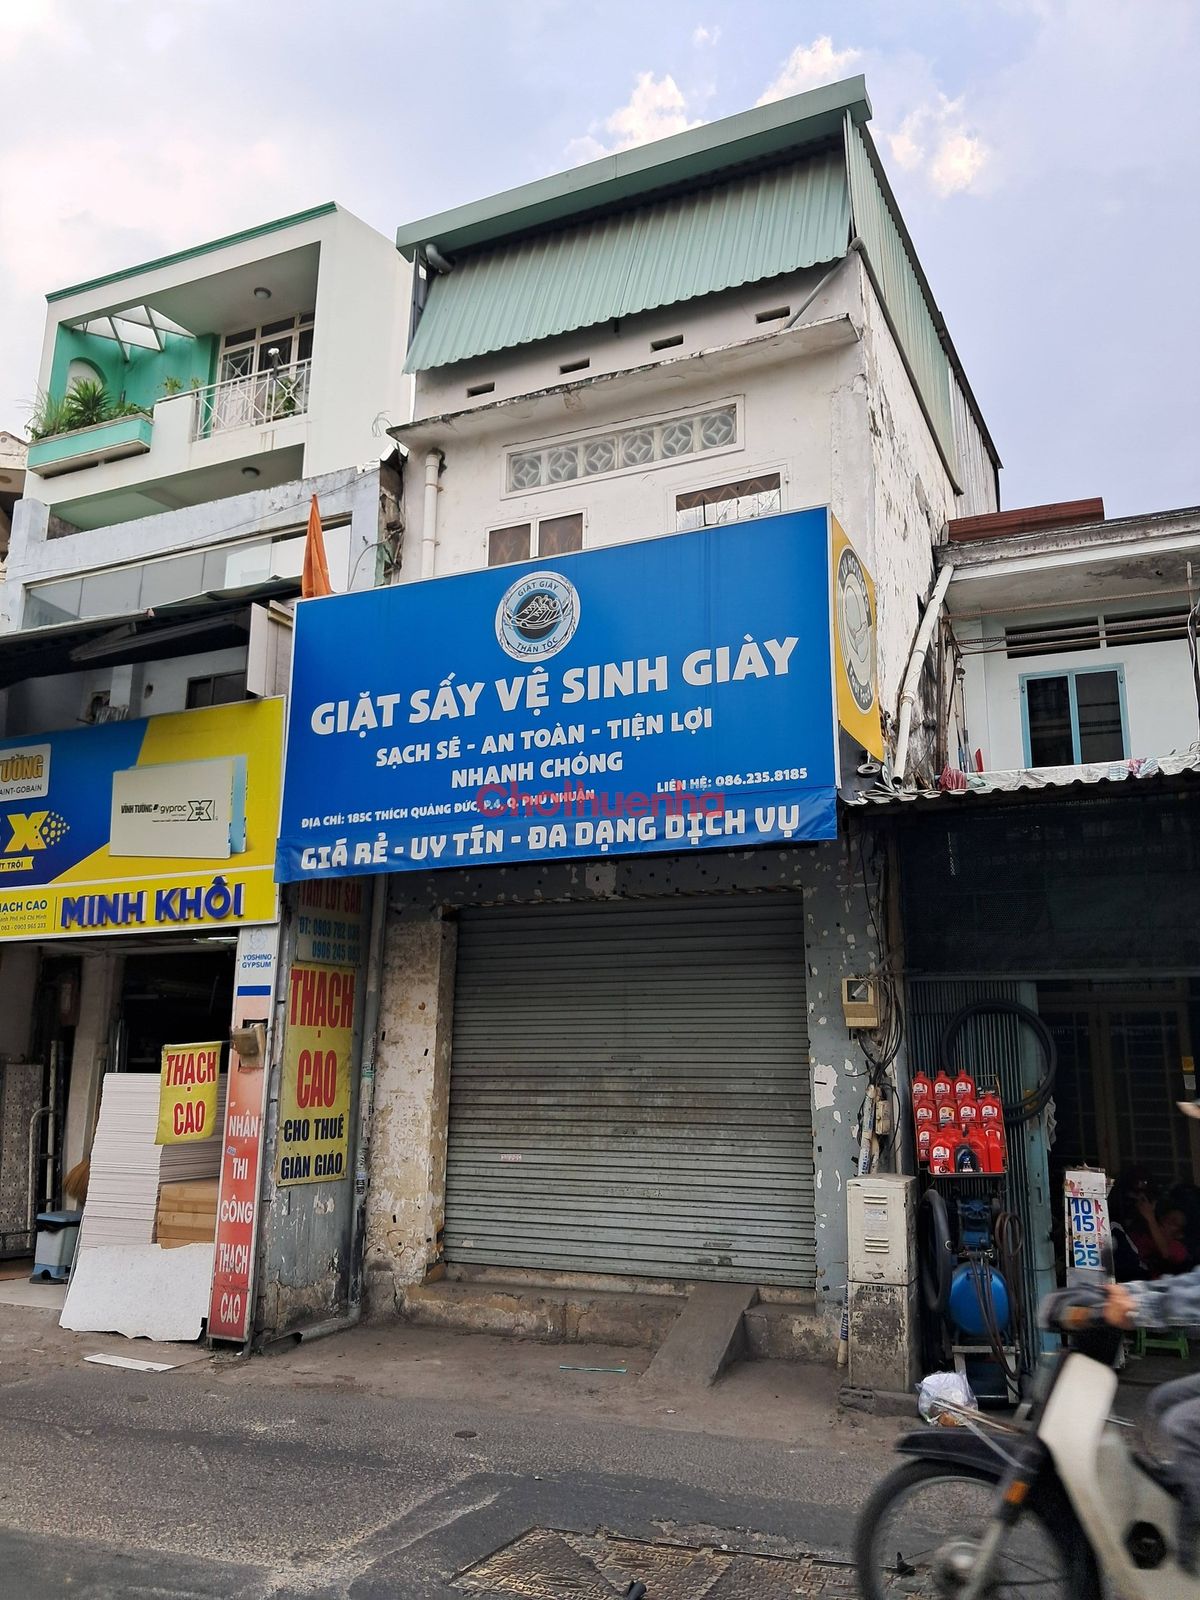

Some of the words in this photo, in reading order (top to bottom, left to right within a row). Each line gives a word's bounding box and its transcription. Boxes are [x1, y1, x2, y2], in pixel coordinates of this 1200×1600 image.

[310, 690, 400, 738] GIẶT
[408, 672, 486, 724] SẤY
[494, 665, 550, 716] VỆ
[561, 655, 668, 704] SINH
[681, 633, 799, 686] GIÀY
[376, 743, 430, 769] SẠCH
[436, 736, 461, 760] SẼ
[481, 733, 514, 755] AN
[520, 722, 585, 749] TOÀN
[606, 712, 664, 741] TIỆN
[671, 706, 713, 735] LỢI
[451, 761, 534, 789] NHANH
[540, 751, 623, 778] CHÓNG
[657, 778, 687, 793] LIÊN
[690, 775, 712, 791] HỆ:
[715, 768, 808, 787] 086.235.8185
[160, 804, 187, 814] gyproc
[301, 816, 321, 830] ĐỊA
[347, 811, 373, 824] 185C
[375, 807, 409, 821] THÍCH
[550, 788, 595, 804] NHUẬN
[300, 838, 348, 870] GIÁ
[354, 832, 389, 866] RẺ
[410, 833, 447, 861] UY
[453, 824, 504, 856] TÍN
[528, 824, 567, 850] ĐA
[575, 816, 657, 852] DẠNG
[665, 808, 746, 845] DỊCH
[754, 804, 800, 838] VỤ
[25, 899, 48, 911] CAO
[61, 890, 148, 928] MINH
[155, 875, 246, 923] KHÔI
[243, 953, 272, 961] YOSHINO
[290, 968, 355, 1039] THẠCH
[166, 1051, 217, 1092] THẠCH
[297, 1049, 337, 1109] CAO
[173, 1100, 206, 1136] CAO
[228, 1109, 258, 1144] NHẬN
[283, 1119, 310, 1143] CHO
[314, 1113, 344, 1141] THUÊ
[232, 1158, 248, 1180] THI
[280, 1153, 310, 1180] GIÀN
[314, 1149, 343, 1177] GIÁO
[220, 1195, 253, 1224] CÔNG
[219, 1244, 248, 1282] THẠCH
[1074, 1249, 1100, 1267] 25
[220, 1292, 240, 1324] CAO
